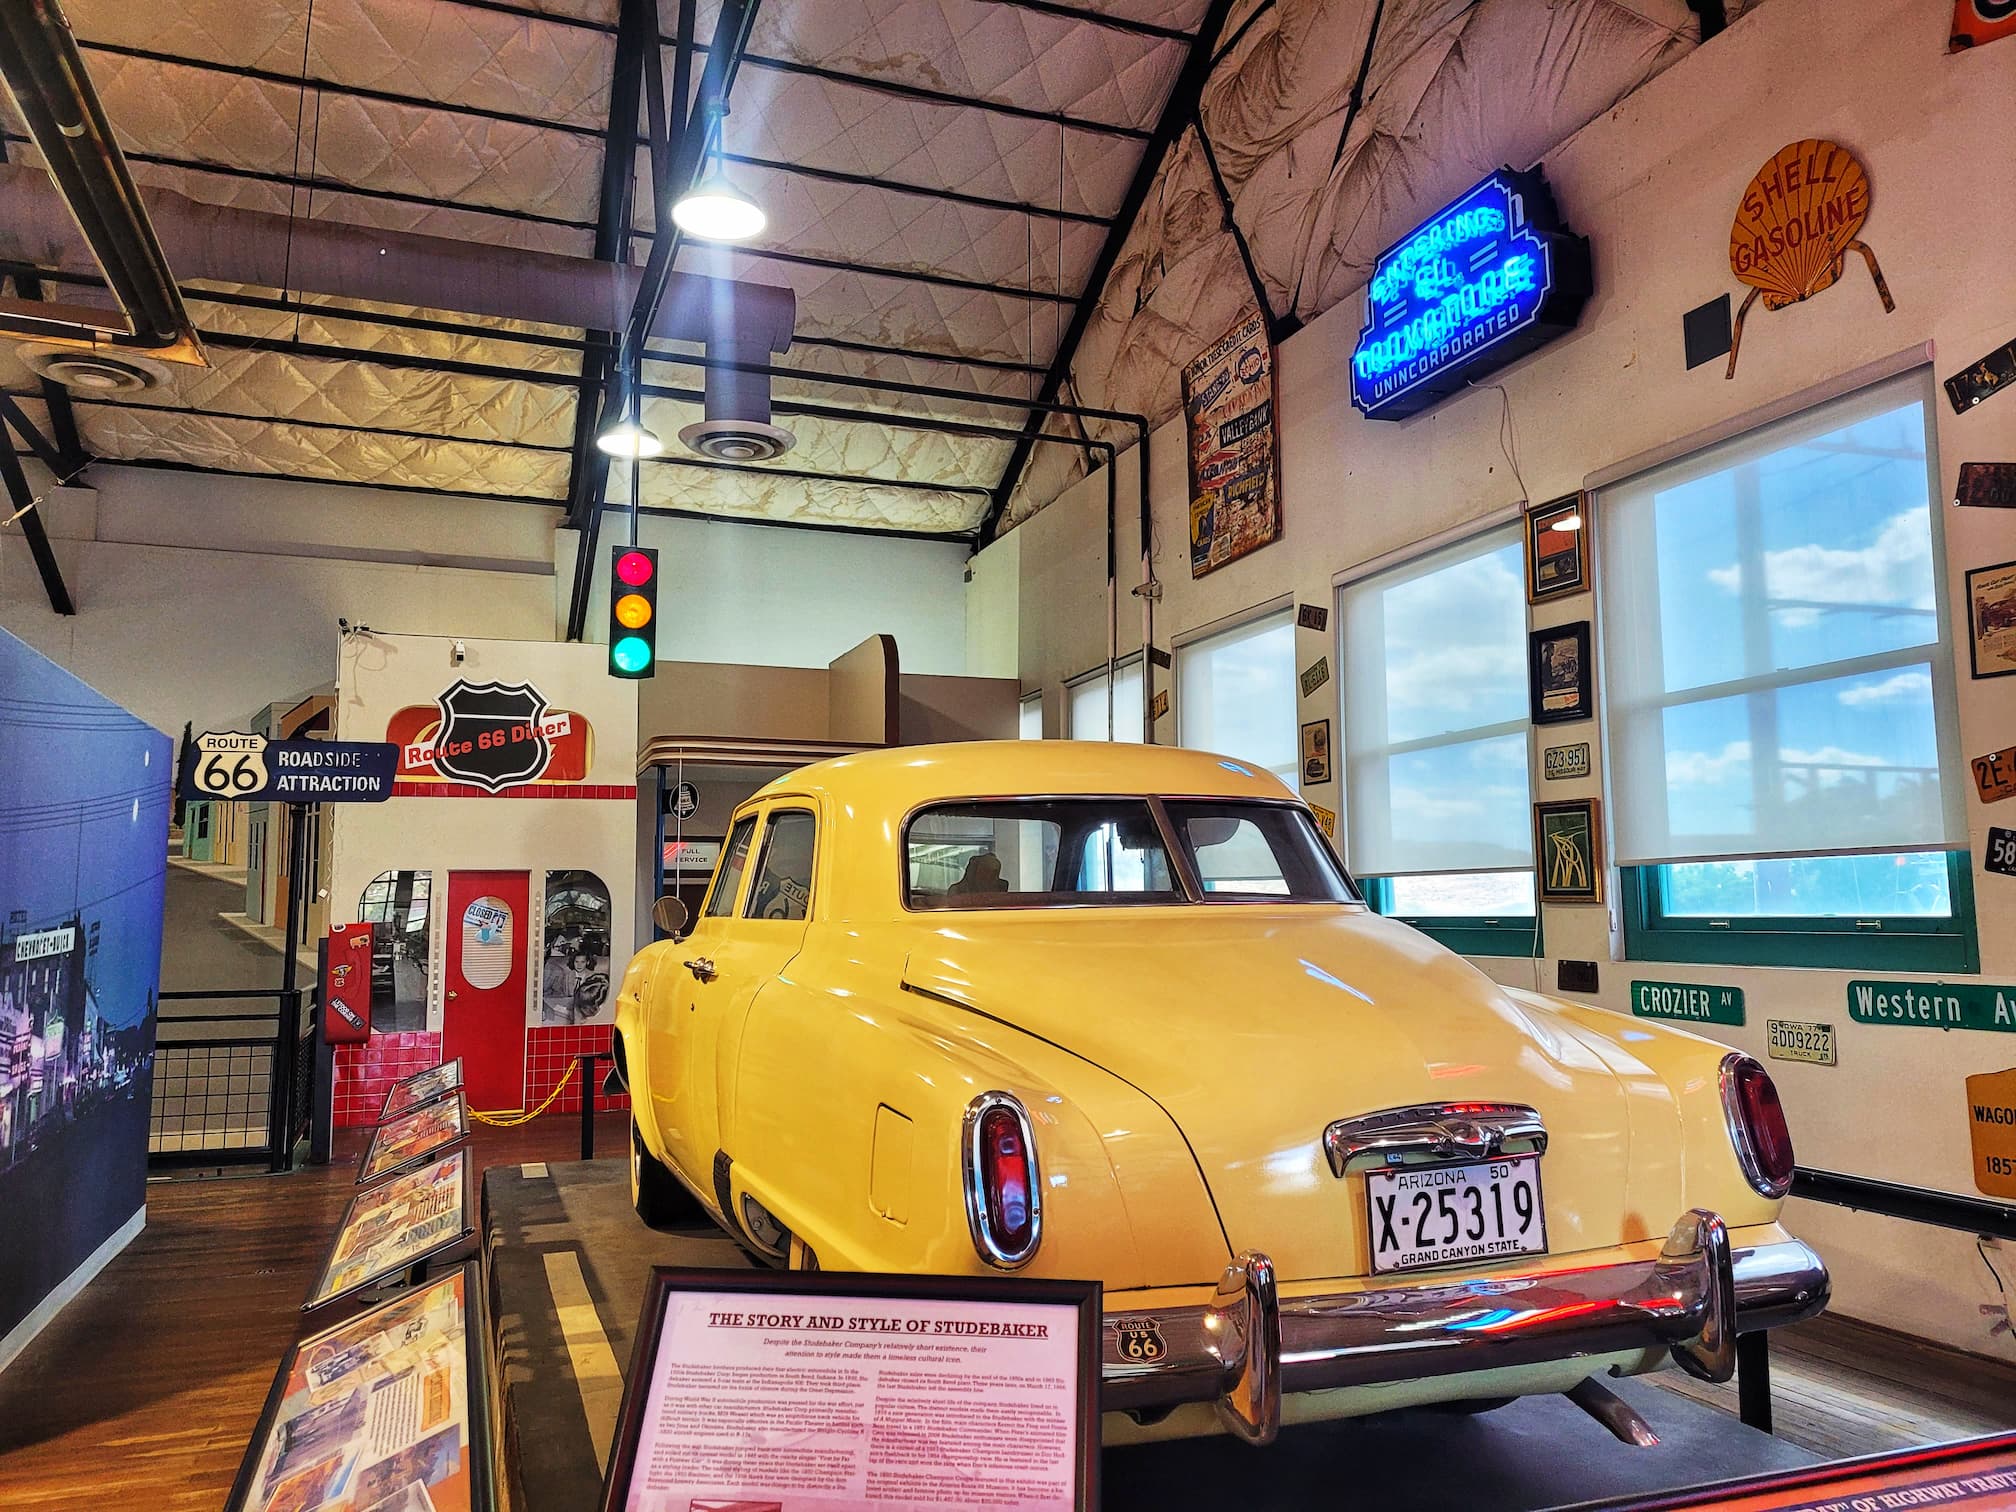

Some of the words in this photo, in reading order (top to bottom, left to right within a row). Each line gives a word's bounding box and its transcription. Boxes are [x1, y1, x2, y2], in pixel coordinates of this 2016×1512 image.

[1744, 151, 1837, 222] SHELL
[1735, 186, 1863, 272] GASOLINE
[1374, 303, 1519, 399] UNINCORPORATED
[206, 737, 259, 750] ROUTE
[408, 741, 473, 764] Route
[477, 725, 506, 747] 66
[511, 718, 569, 743] Diner
[203, 753, 259, 792] 66
[278, 751, 361, 768] ROADSIDE
[277, 776, 381, 792] ATTRACTION
[681, 847, 700, 855] FULL
[1640, 985, 1710, 1017] CROZIER
[1721, 991, 1732, 1007] AV
[1855, 986, 1961, 1022] Western
[1398, 1170, 1467, 1191] ARIZONA
[1490, 1165, 1510, 1180] 50
[1375, 1180, 1534, 1253] X-25319
[1401, 1250, 1440, 1265] GRAND
[1441, 1244, 1486, 1262] CANYON
[1487, 1239, 1520, 1253] STATE
[710, 1313, 743, 1325] THE
[748, 1314, 803, 1328] STORY
[806, 1316, 844, 1330] AND
[849, 1317, 901, 1331] STYLE
[906, 1319, 930, 1333] OF
[934, 1320, 1049, 1337] STUDEBAKER
[1121, 1321, 1151, 1330] ROUTE
[763, 1338, 790, 1347] Despite
[803, 1339, 842, 1348] Studebaker
[844, 1341, 882, 1351] Company's
[883, 1342, 915, 1352] relatively
[916, 1344, 934, 1352] short
[785, 1350, 815, 1358] attention
[825, 1352, 841, 1360] style
[863, 1353, 881, 1361] them
[888, 1354, 917, 1362] timeless
[918, 1355, 944, 1363] cultural
[1128, 1338, 1158, 1358] 66
[1851, 1496, 1880, 1512] OF
[1881, 1479, 1967, 1509] HIGHWAY
